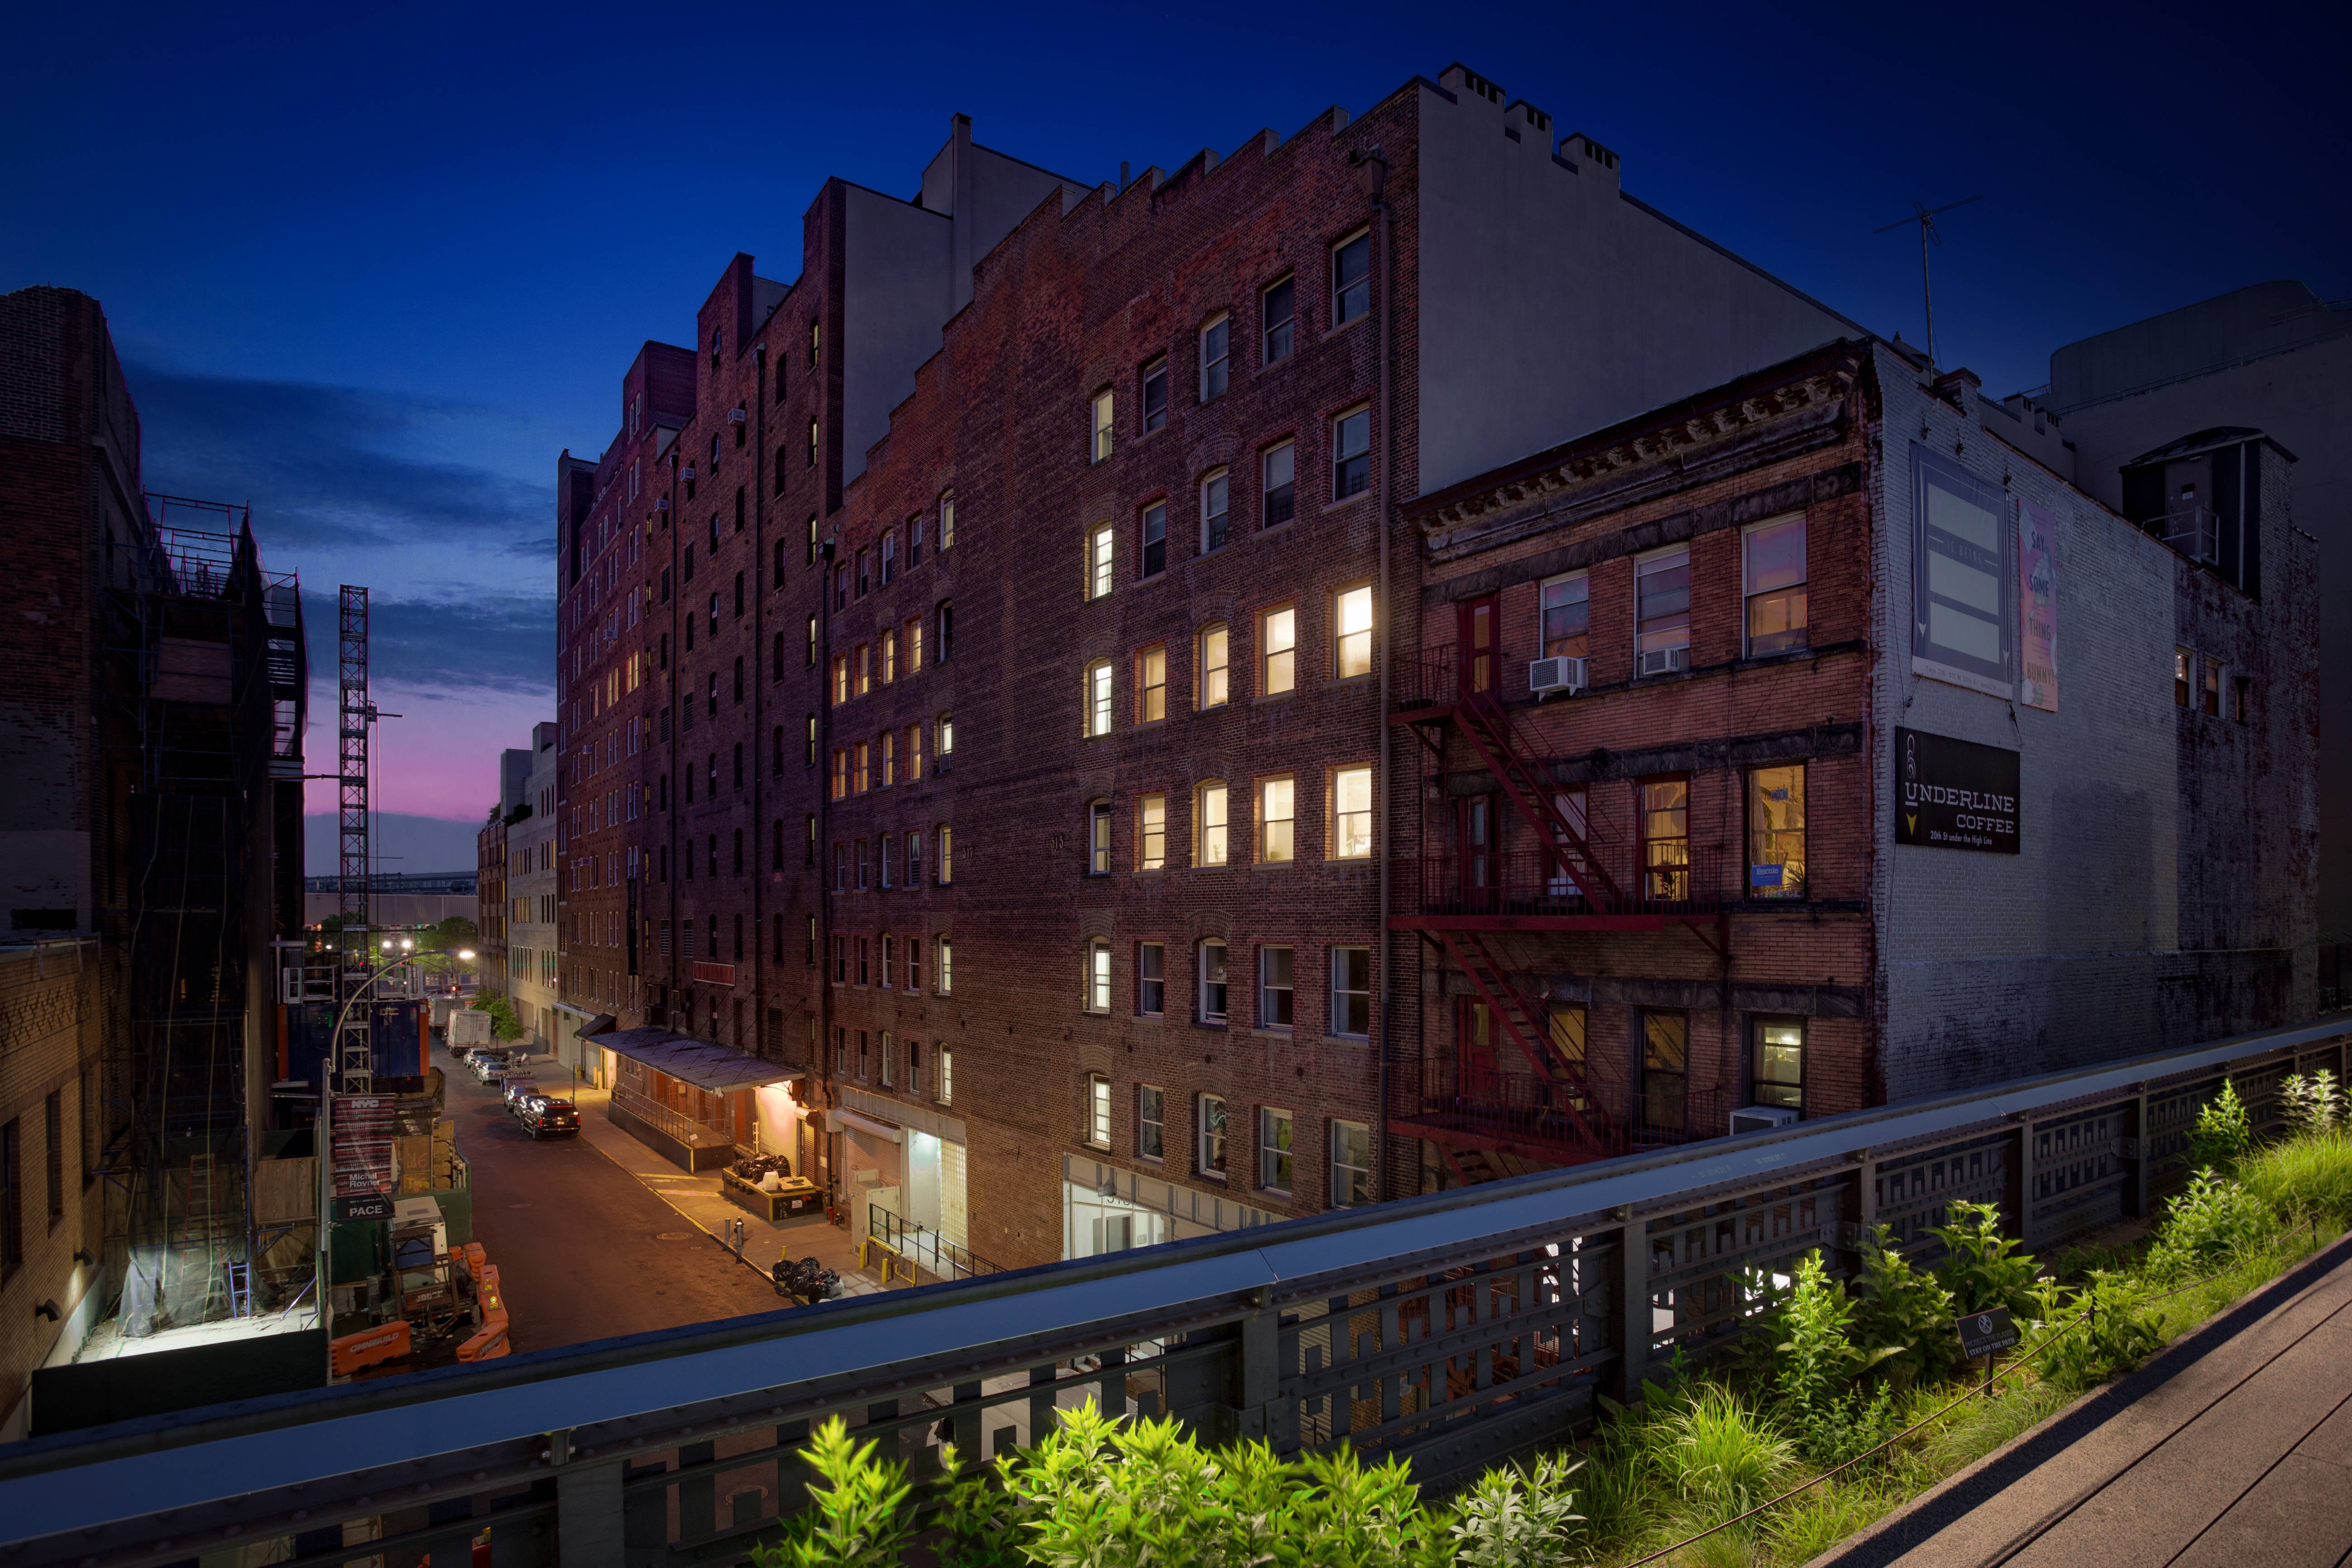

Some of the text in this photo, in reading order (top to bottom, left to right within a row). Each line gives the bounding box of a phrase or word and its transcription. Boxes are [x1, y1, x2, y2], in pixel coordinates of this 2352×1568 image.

[2032, 531, 2044, 552] SAY
[2029, 573, 2049, 598] SOME
[2029, 619, 2051, 641] THING
[2027, 662, 2055, 686] BUNNY!
[1905, 782, 2014, 812] UNDERLINE
[1956, 814, 2014, 834] COFFEE
[1930, 830, 1941, 840] 20th
[1943, 832, 1948, 840] St
[1949, 833, 1962, 842] under
[1972, 834, 1982, 846] High
[1983, 836, 1992, 845] Line
[351, 1099, 379, 1108] NYC
[350, 1172, 377, 1181] Michal
[350, 1205, 383, 1216] PACE
[350, 1332, 399, 1352] OMNIBUILD
[1965, 1337, 1987, 1348] PROTECT
[1996, 1329, 2014, 1339] PLANTS
[1969, 1346, 1982, 1356] STAY
[1991, 1341, 2002, 1349] THE
[2002, 1338, 2016, 1347] PATH
